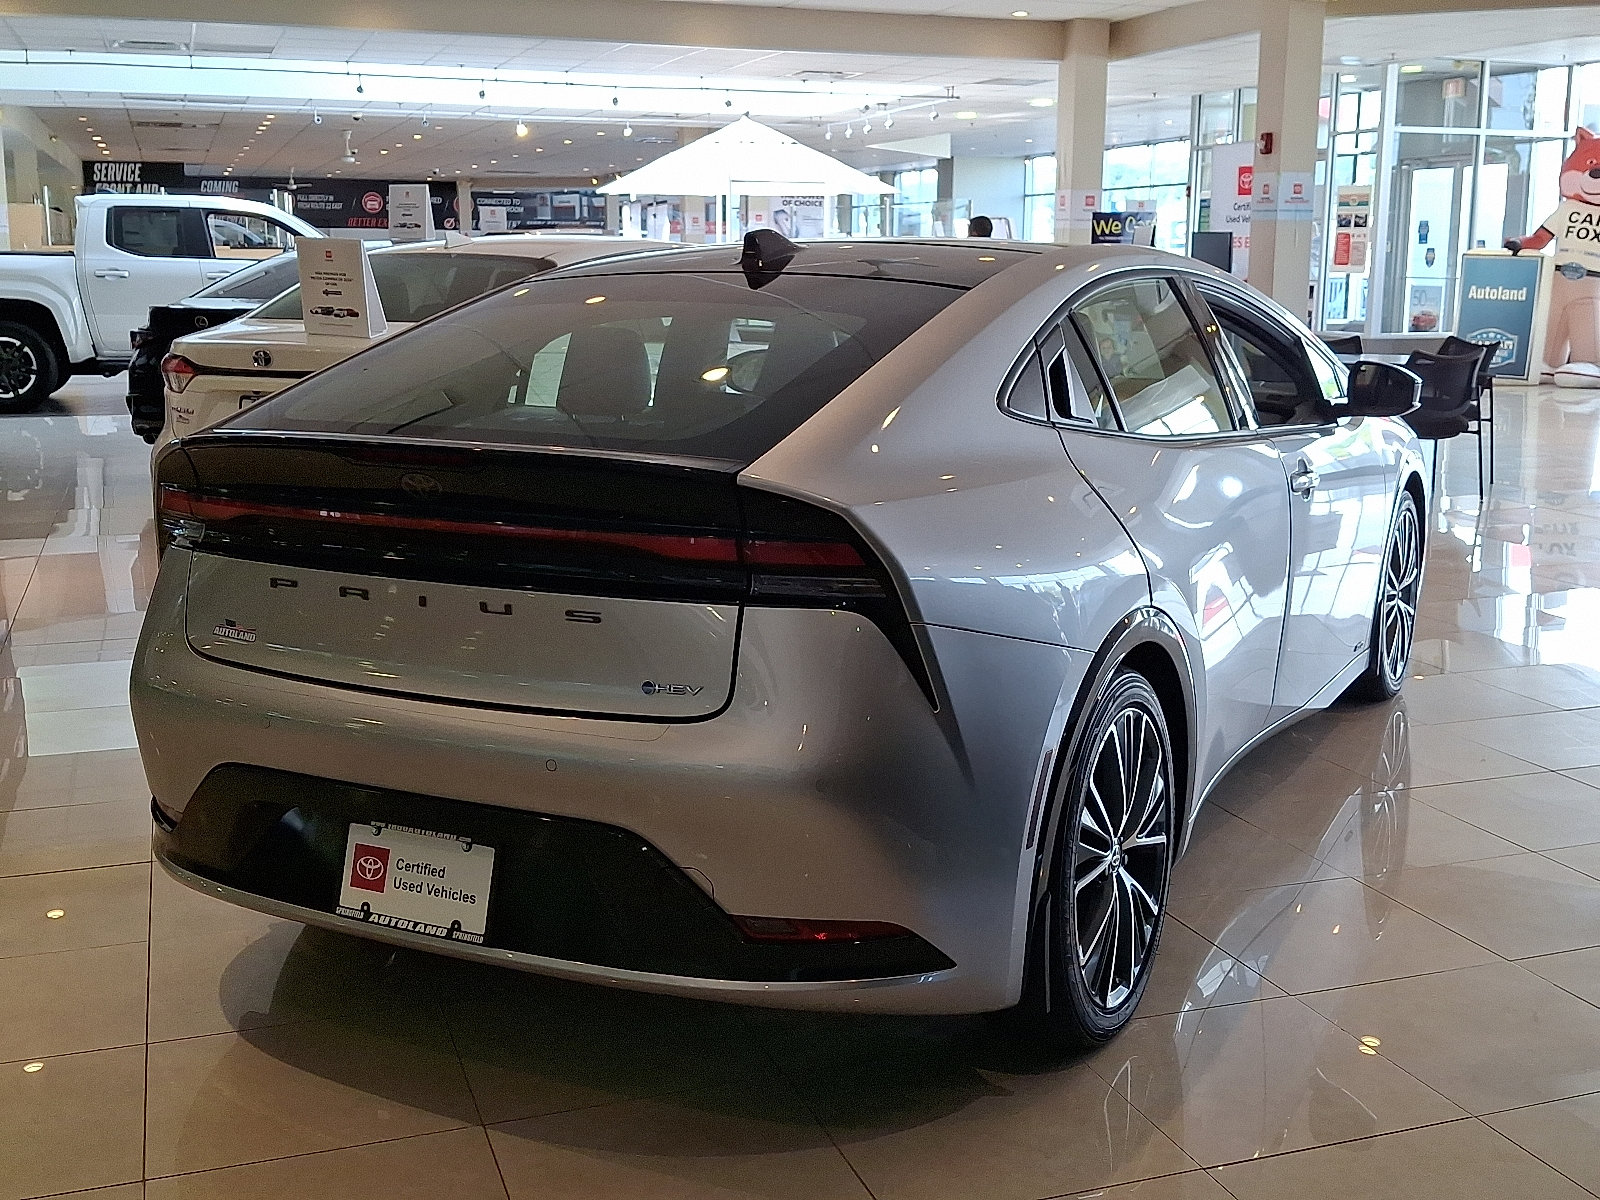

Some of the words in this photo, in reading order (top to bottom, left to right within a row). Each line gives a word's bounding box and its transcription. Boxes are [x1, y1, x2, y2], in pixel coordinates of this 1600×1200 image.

[93, 162, 142, 182] SERVICE
[200, 180, 239, 193] COMING
[347, 217, 377, 228] BETTER
[1092, 217, 1122, 236] We
[1467, 284, 1528, 302] Autoland
[269, 576, 602, 624] PRIUS
[213, 625, 257, 642] AUTOLAND
[656, 683, 704, 696] HEV
[395, 857, 447, 879] Certified
[393, 876, 424, 894] Used
[426, 882, 477, 905] Vehicles
[335, 906, 365, 919] SPRINGFIELD
[368, 913, 448, 937] AUTOLAND
[452, 930, 484, 944] SPRINGFIELD
